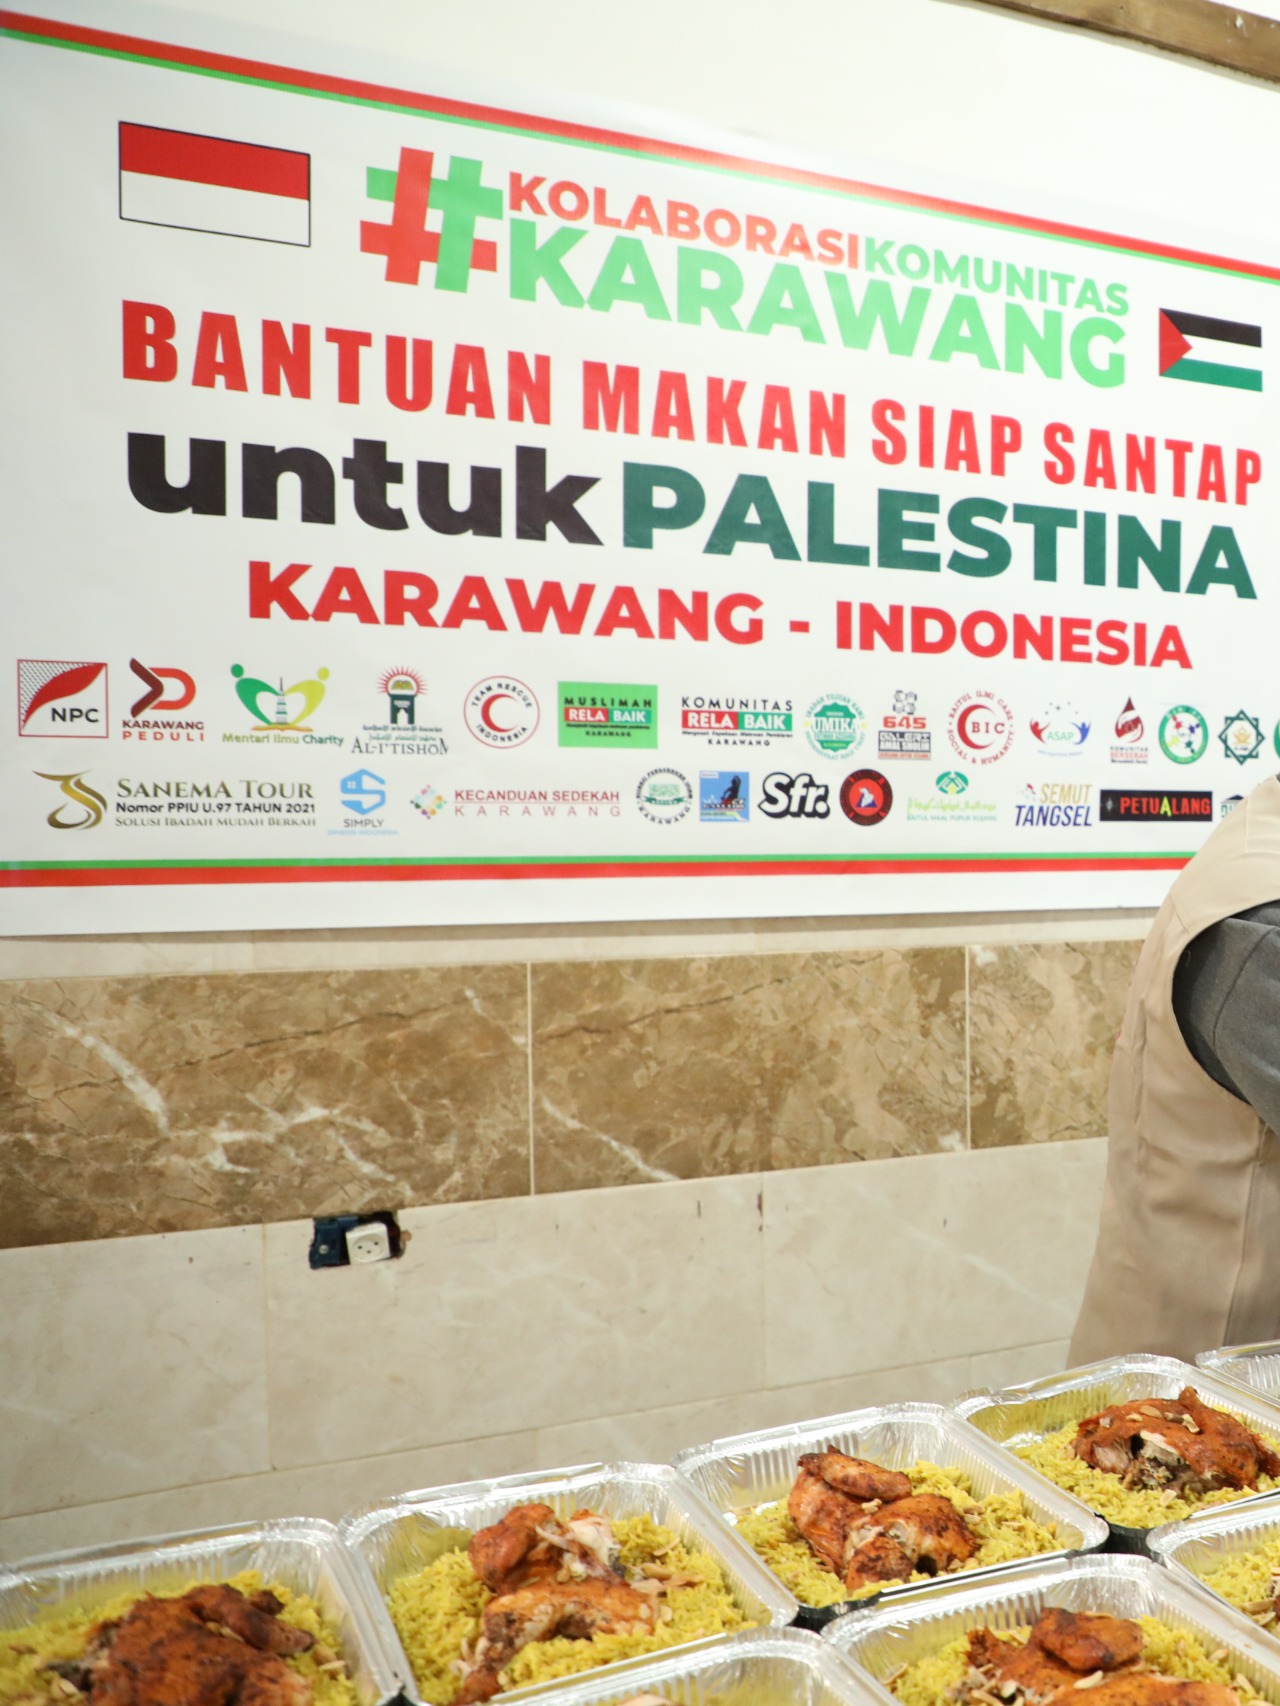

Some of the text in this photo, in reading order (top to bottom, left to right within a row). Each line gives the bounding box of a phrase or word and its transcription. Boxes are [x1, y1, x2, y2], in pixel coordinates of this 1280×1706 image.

[509, 171, 1130, 317] KOLABORASI KOMUNITAS
[509, 217, 1126, 389] KARAWANG
[121, 299, 1262, 506] BANTUAN MAKAN SIAP SANTAP
[126, 431, 1258, 600] untuk PALESTINA
[248, 560, 1194, 669] KARAWANG - INDONESIA
[472, 683, 532, 709] TEAM RESCUE
[564, 697, 652, 708] MUSLIMAH
[681, 696, 793, 711] KOMUNITAS
[51, 706, 100, 724] NPC
[569, 708, 647, 723] RELA BAIK
[997, 699, 1013, 721] CARE
[122, 719, 205, 731] KARAWANG
[687, 711, 786, 730] RELA BAIK
[812, 718, 859, 733] UMIKA
[882, 716, 927, 730] 645
[971, 721, 1005, 734] BIC
[122, 730, 205, 742] PEDULI
[222, 732, 344, 747] Mentari Ilmu Charity
[476, 723, 528, 742] INDONESIA
[1047, 731, 1075, 741] ASAP
[708, 739, 770, 747] KARAWANG
[947, 729, 967, 760] SOCIAL
[981, 731, 1015, 765] HUMANITY
[116, 778, 314, 799] SANEMA TOUR
[455, 790, 620, 802] KECANDUAN SEDEKAH
[1039, 783, 1093, 805] SEMUT
[115, 802, 316, 814] Nomor PPIU U.97 TAHUN 2021
[455, 804, 621, 818] KARAWANG
[1119, 796, 1212, 818] PETUALANG
[115, 816, 316, 828] SOLUSI IBADAH MUDAH BERKAH
[344, 818, 385, 828] SIMPLY
[1014, 805, 1092, 827] TANGSEL
